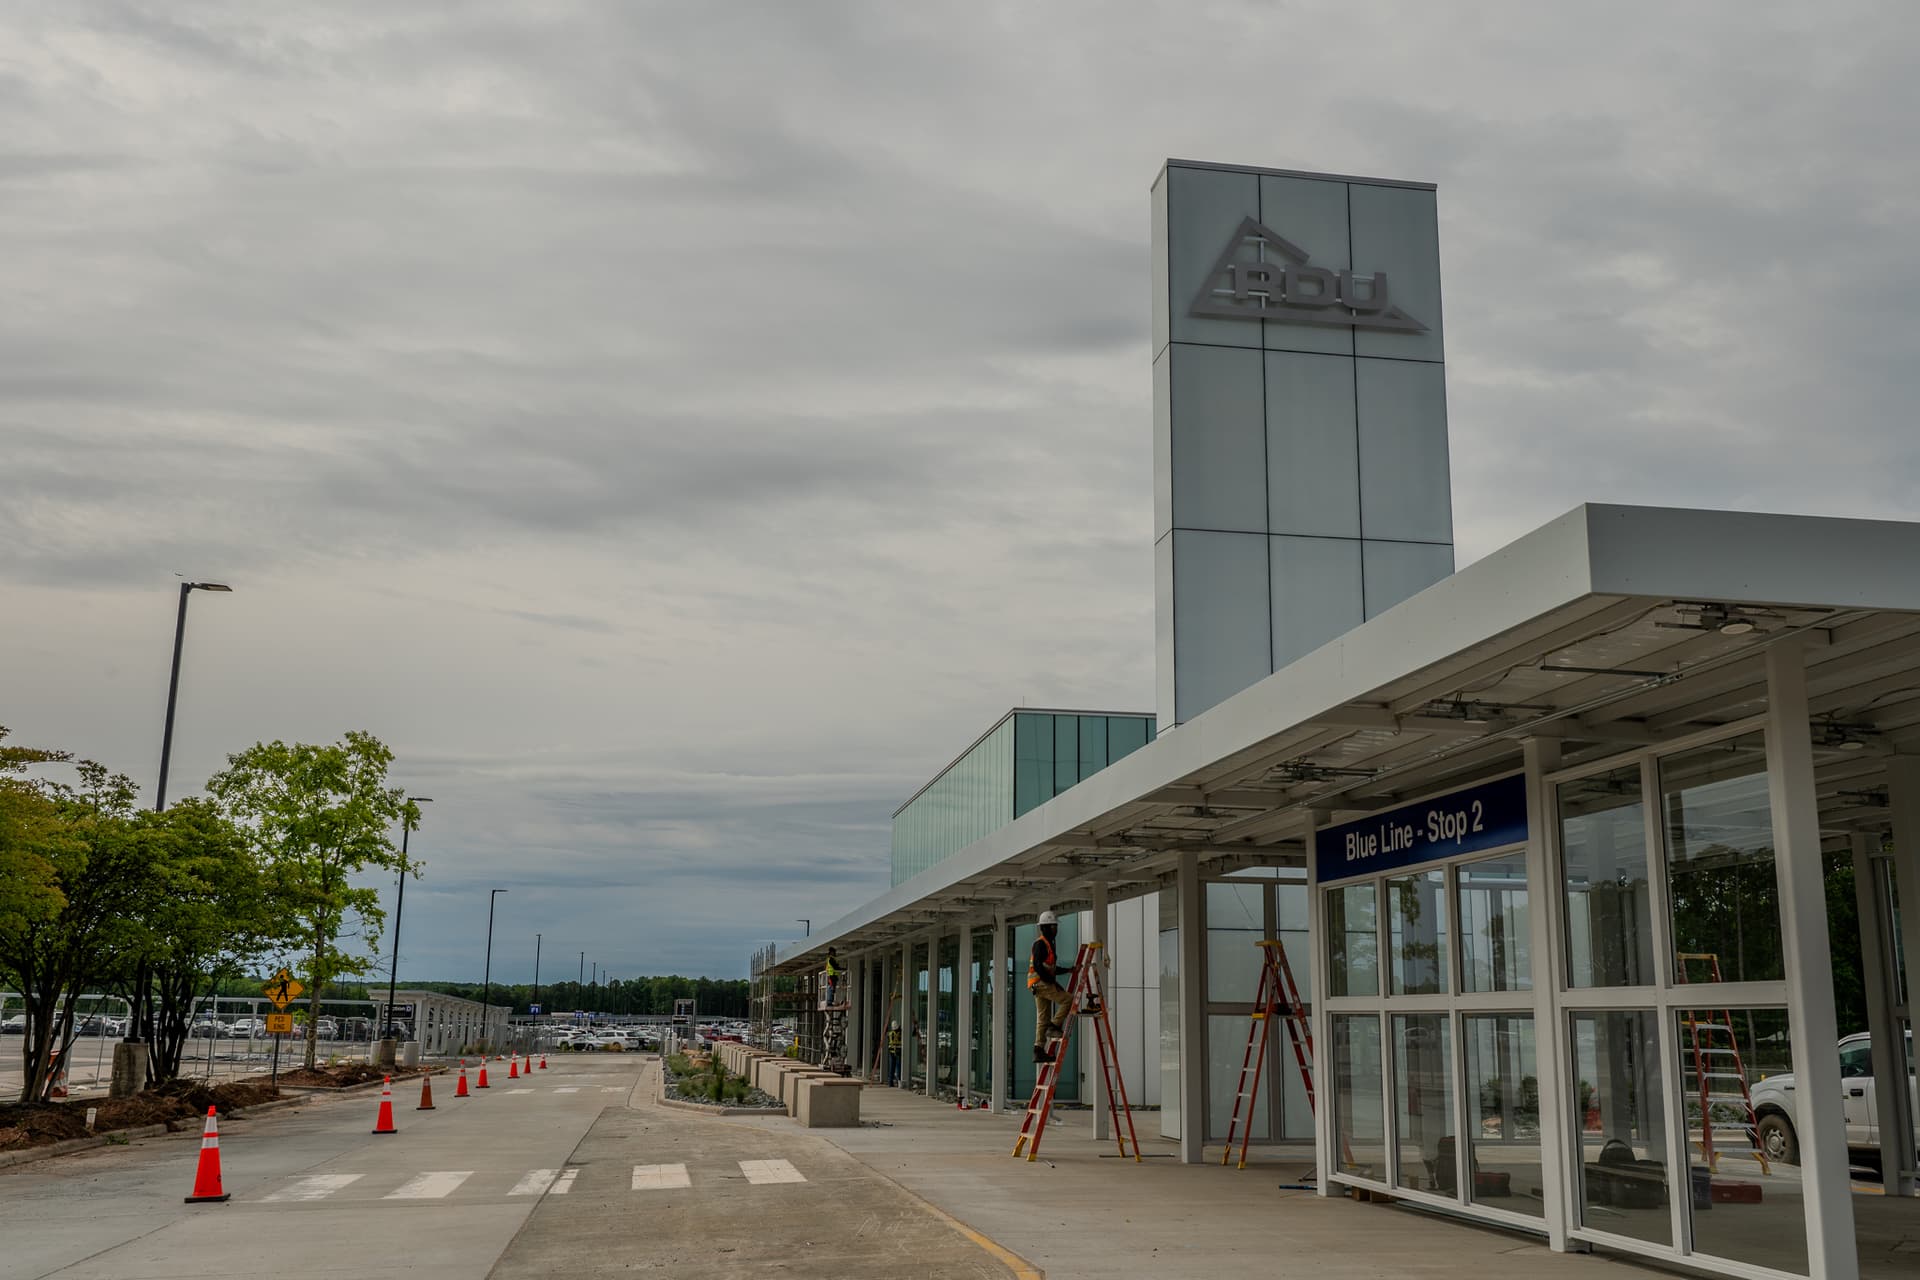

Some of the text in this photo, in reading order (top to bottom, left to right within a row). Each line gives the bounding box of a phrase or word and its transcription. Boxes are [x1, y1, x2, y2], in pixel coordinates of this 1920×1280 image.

[1235, 264, 1387, 310] RDU
[1346, 832, 1377, 861] Blue
[1381, 822, 1413, 853] Line
[1427, 811, 1467, 844] Stop
[1472, 800, 1483, 832] 2
